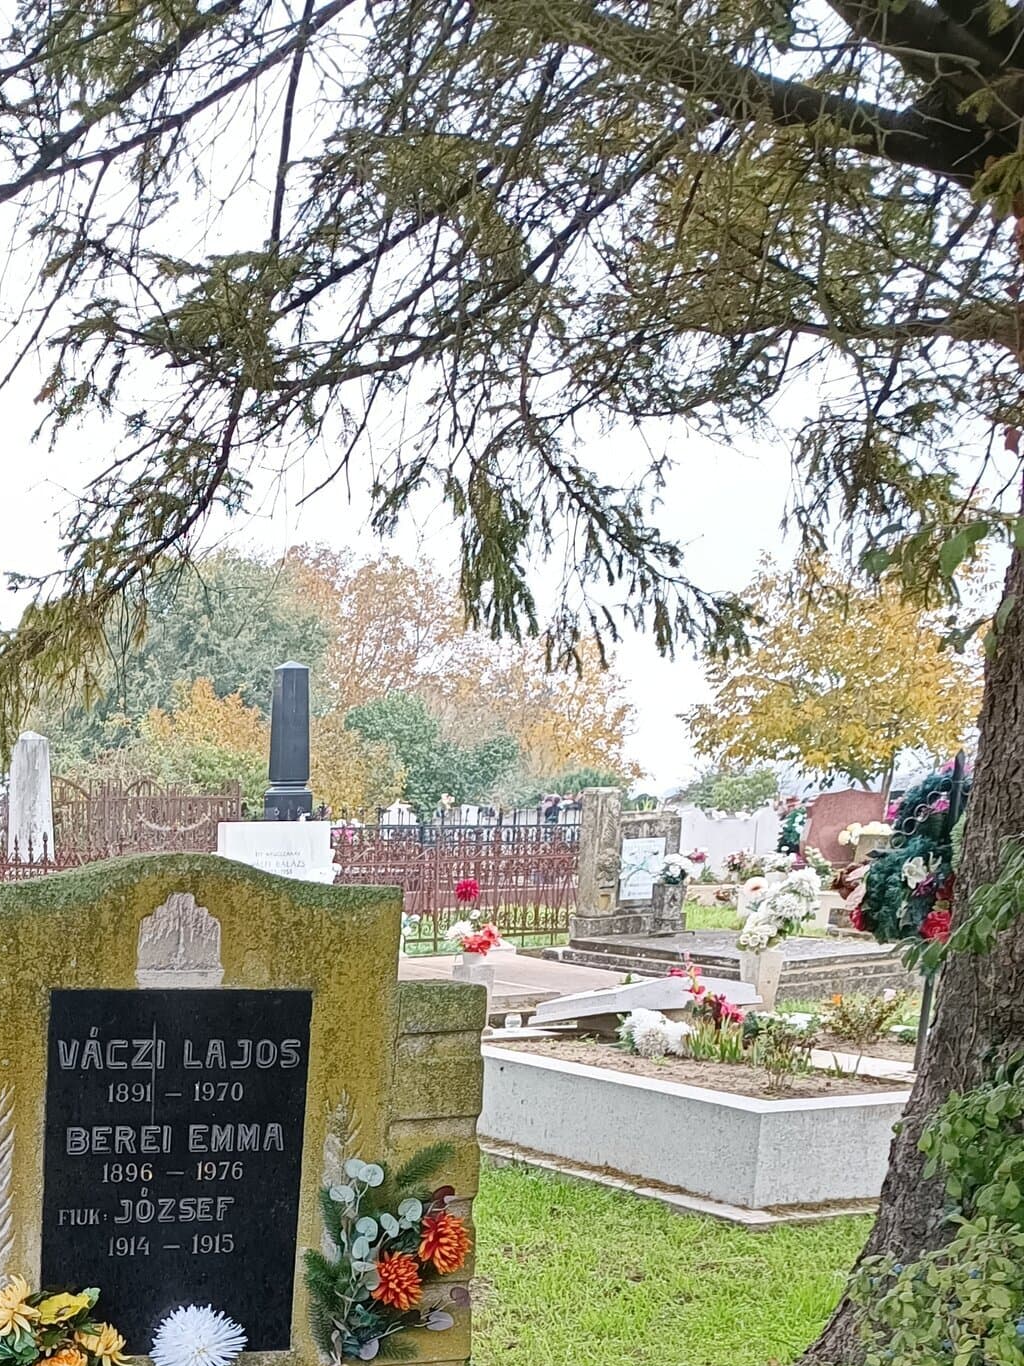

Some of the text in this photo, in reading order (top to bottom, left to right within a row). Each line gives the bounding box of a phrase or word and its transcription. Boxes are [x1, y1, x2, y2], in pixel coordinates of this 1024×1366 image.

[57, 1026, 301, 1070] VÁCZI LAJOS
[108, 1082, 152, 1103] 1891
[194, 1081, 244, 1102] 1970
[66, 1123, 285, 1155] BEREI EMMA
[102, 1162, 153, 1183] 1896
[196, 1160, 244, 1181] 1976
[114, 1187, 235, 1224] JÓZSEF
[108, 1236, 150, 1257] 1914
[192, 1233, 235, 1255] 1915
